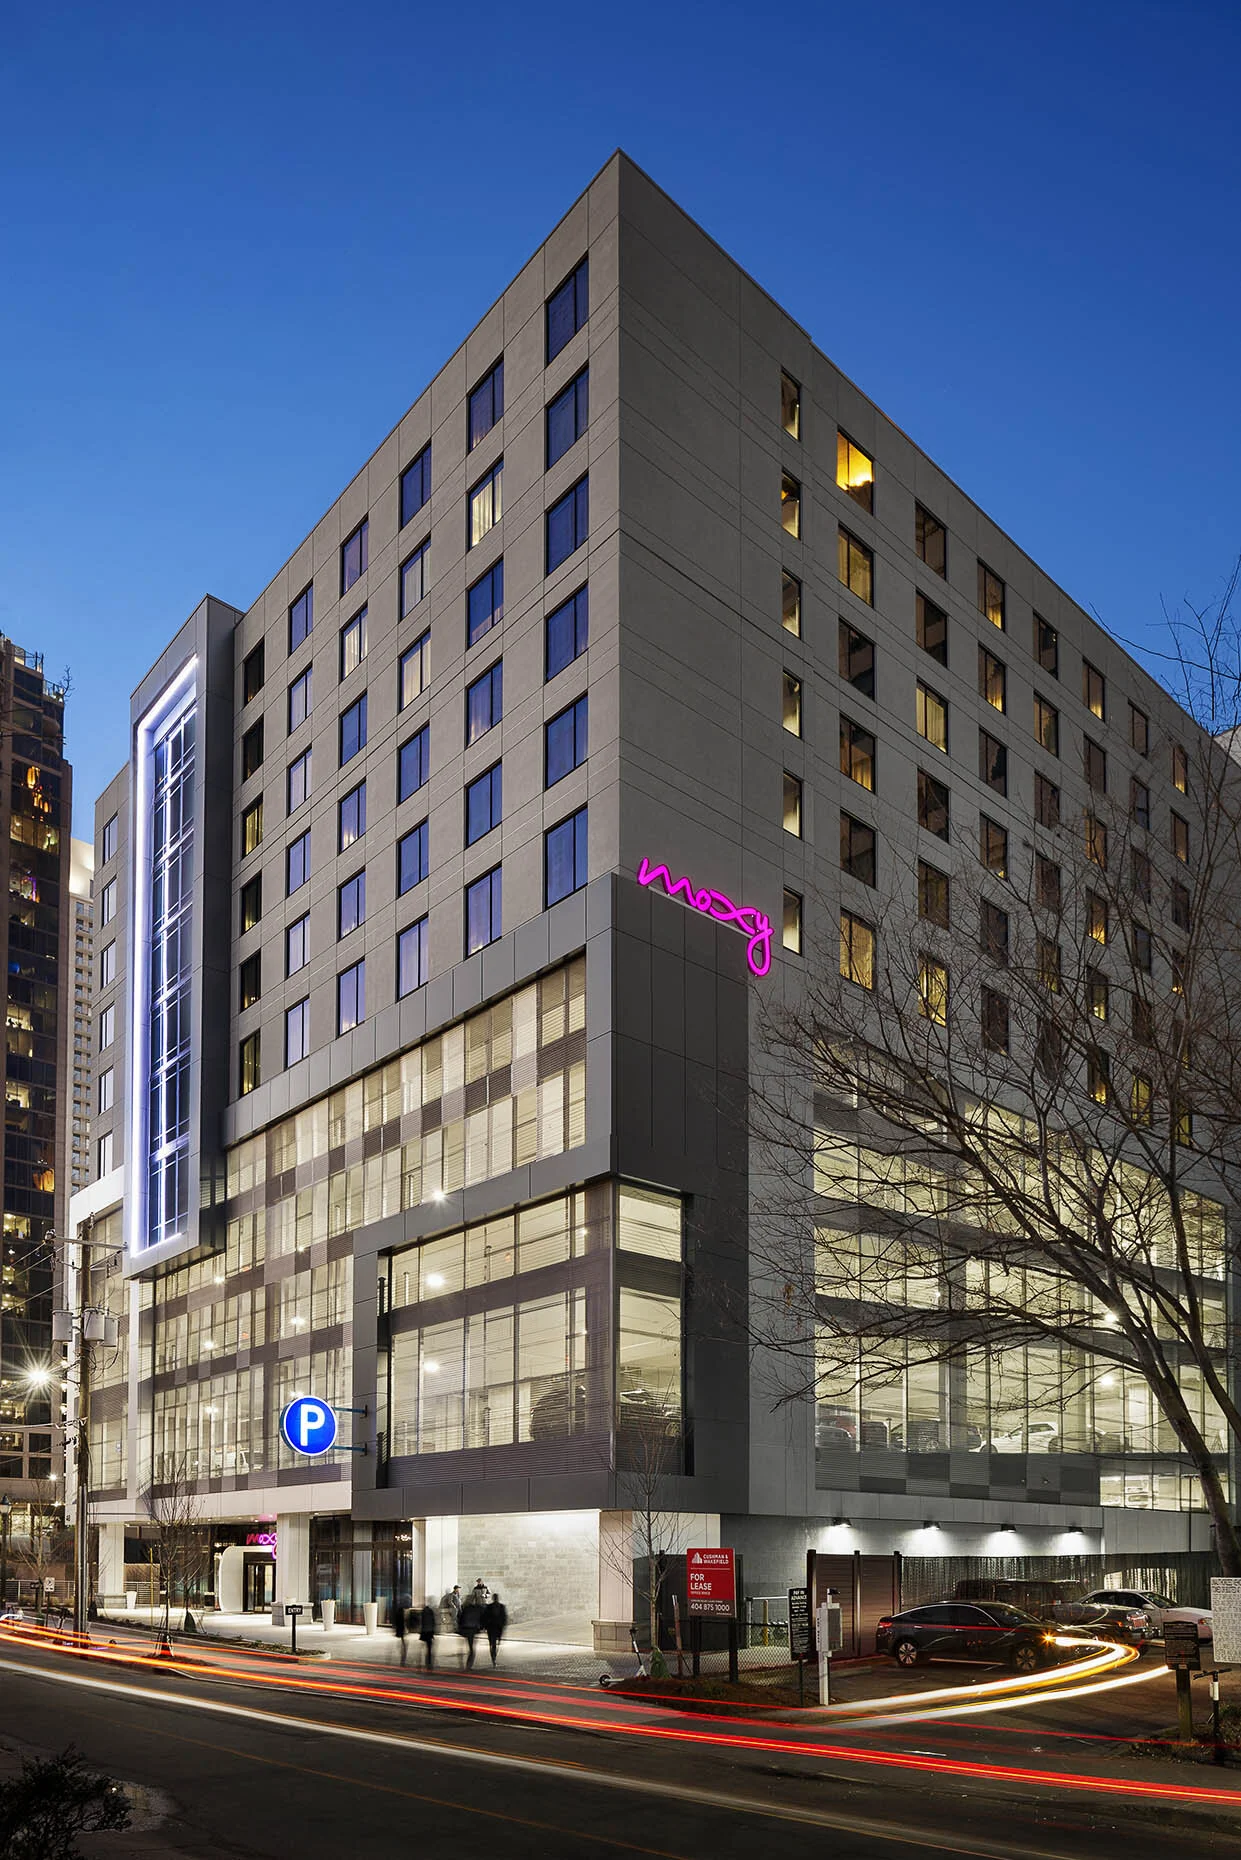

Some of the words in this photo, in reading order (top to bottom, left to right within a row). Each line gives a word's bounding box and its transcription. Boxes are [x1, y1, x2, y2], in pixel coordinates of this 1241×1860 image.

[300, 1403, 326, 1447] P
[690, 1573, 705, 1581] FOR
[690, 1582, 712, 1591] LEASE
[691, 1602, 702, 1610] 404
[703, 1603, 714, 1611] 875
